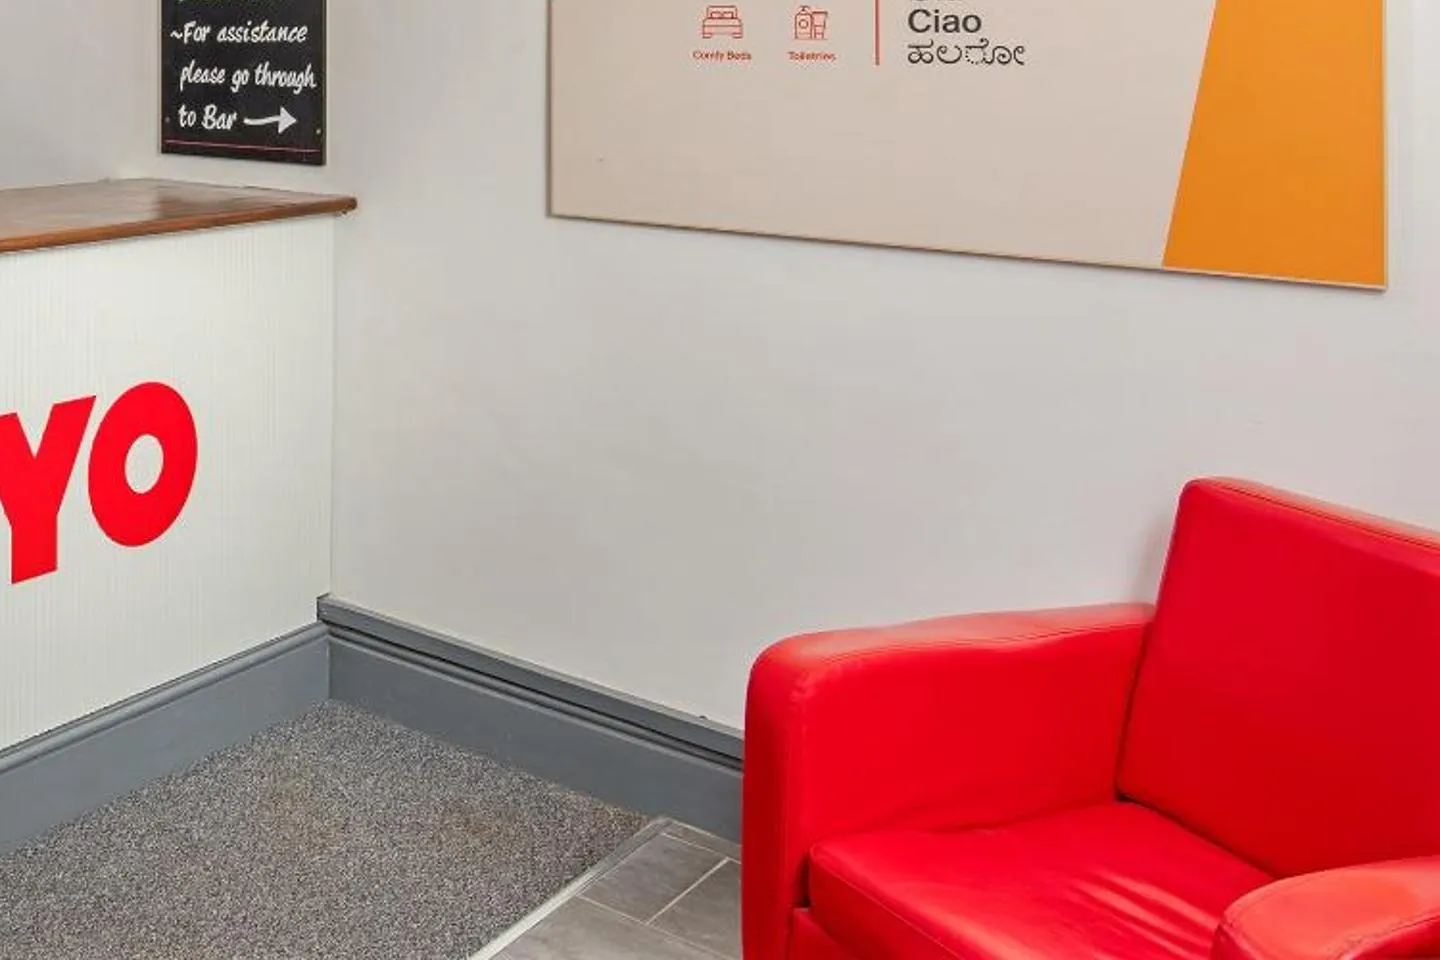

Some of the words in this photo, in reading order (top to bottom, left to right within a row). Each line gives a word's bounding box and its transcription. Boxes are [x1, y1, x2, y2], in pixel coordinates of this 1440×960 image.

[217, 21, 308, 43] assistance
[908, 9, 982, 33] Ciao
[180, 60, 225, 91] please
[231, 70, 249, 93] go
[255, 62, 317, 94] through
[178, 105, 197, 127] to
[202, 104, 237, 130] Bar
